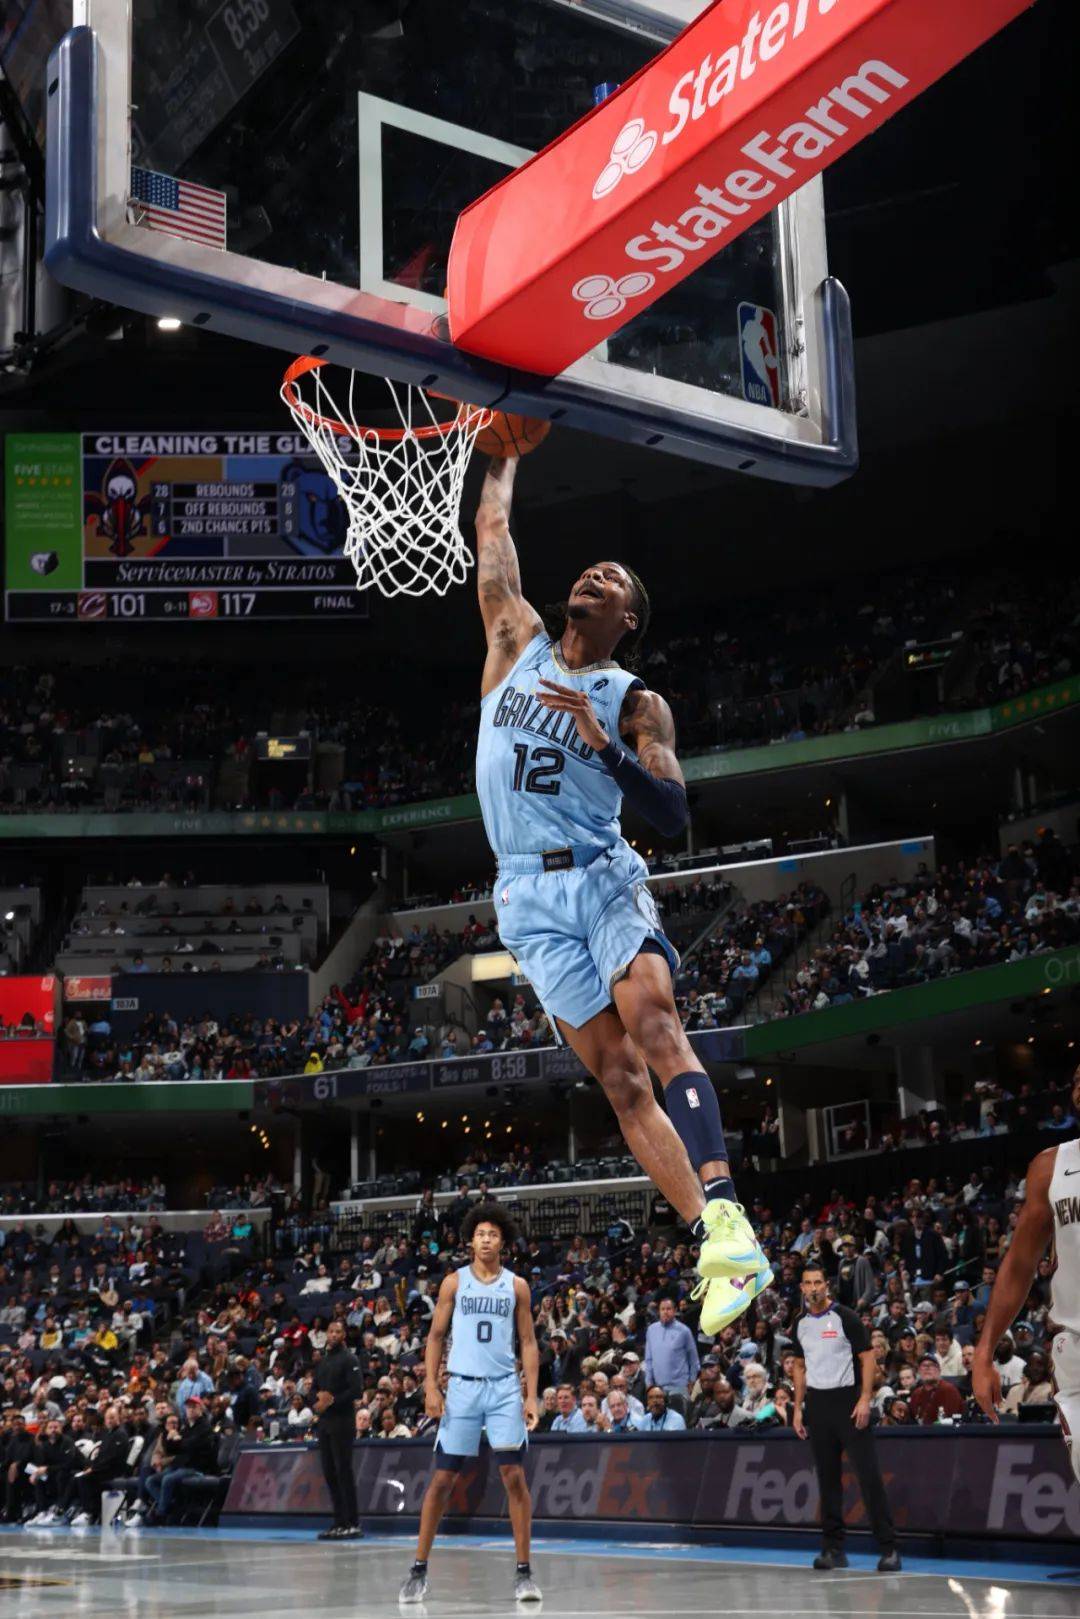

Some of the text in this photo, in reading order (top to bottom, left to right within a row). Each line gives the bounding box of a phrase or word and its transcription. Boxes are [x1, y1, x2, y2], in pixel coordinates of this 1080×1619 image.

[661, 0, 836, 145] State
[748, 382, 767, 401] NBA
[96, 436, 352, 454] CLEANING THE GLS
[14, 465, 41, 476] FIVE
[196, 484, 255, 497] REBOUNDS
[158, 502, 165, 516] 7
[185, 502, 206, 516] OFF
[208, 502, 266, 516] REBOUNDS
[181, 520, 203, 534] 2ND
[205, 520, 248, 534] CHANCE
[251, 520, 271, 534] PTS
[247, 565, 263, 586] by
[265, 561, 336, 580] STRATOS
[111, 593, 145, 616] 101
[221, 593, 256, 615] 117
[314, 595, 355, 609] FINAL
[513, 743, 566, 796] 12
[174, 818, 201, 830] FIVE
[382, 805, 451, 826] EXPERIENCE
[491, 1055, 526, 1079] 8:58
[313, 1075, 337, 1099] 61
[461, 1295, 511, 1317] GRIZZLIES
[477, 1320, 492, 1343] 0
[368, 1450, 480, 1513] Fedx
[530, 1447, 658, 1514] FedEx
